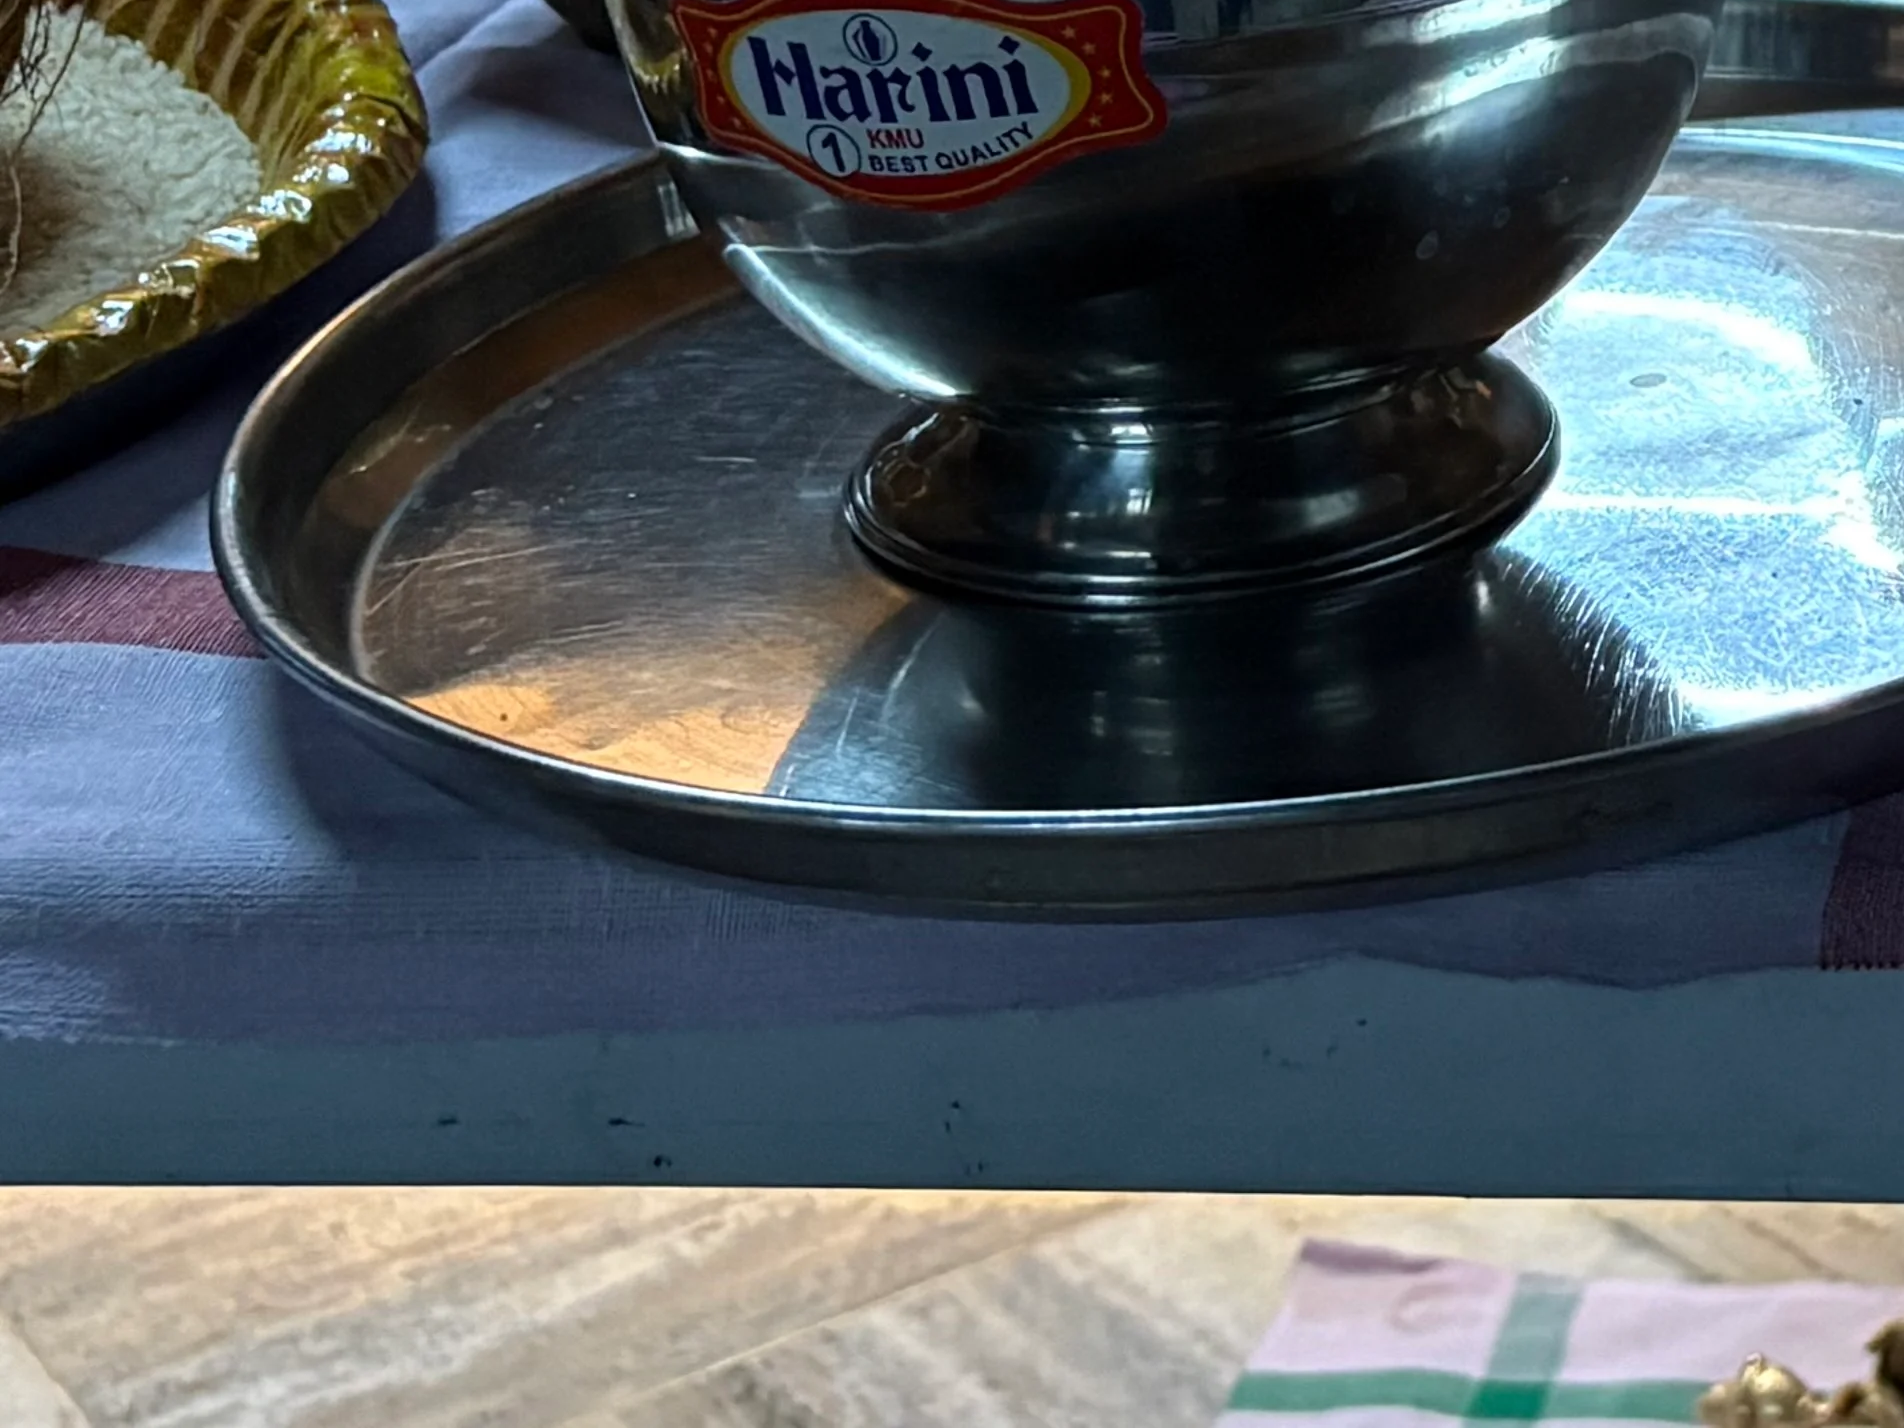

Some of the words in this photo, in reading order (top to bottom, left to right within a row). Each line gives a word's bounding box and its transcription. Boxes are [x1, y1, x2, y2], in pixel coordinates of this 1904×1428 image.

[746, 35, 1039, 124] Harini
[821, 132, 847, 174] 1
[866, 127, 925, 150] KMU
[868, 154, 929, 174] BEST
[934, 121, 1035, 170] QUALITY
